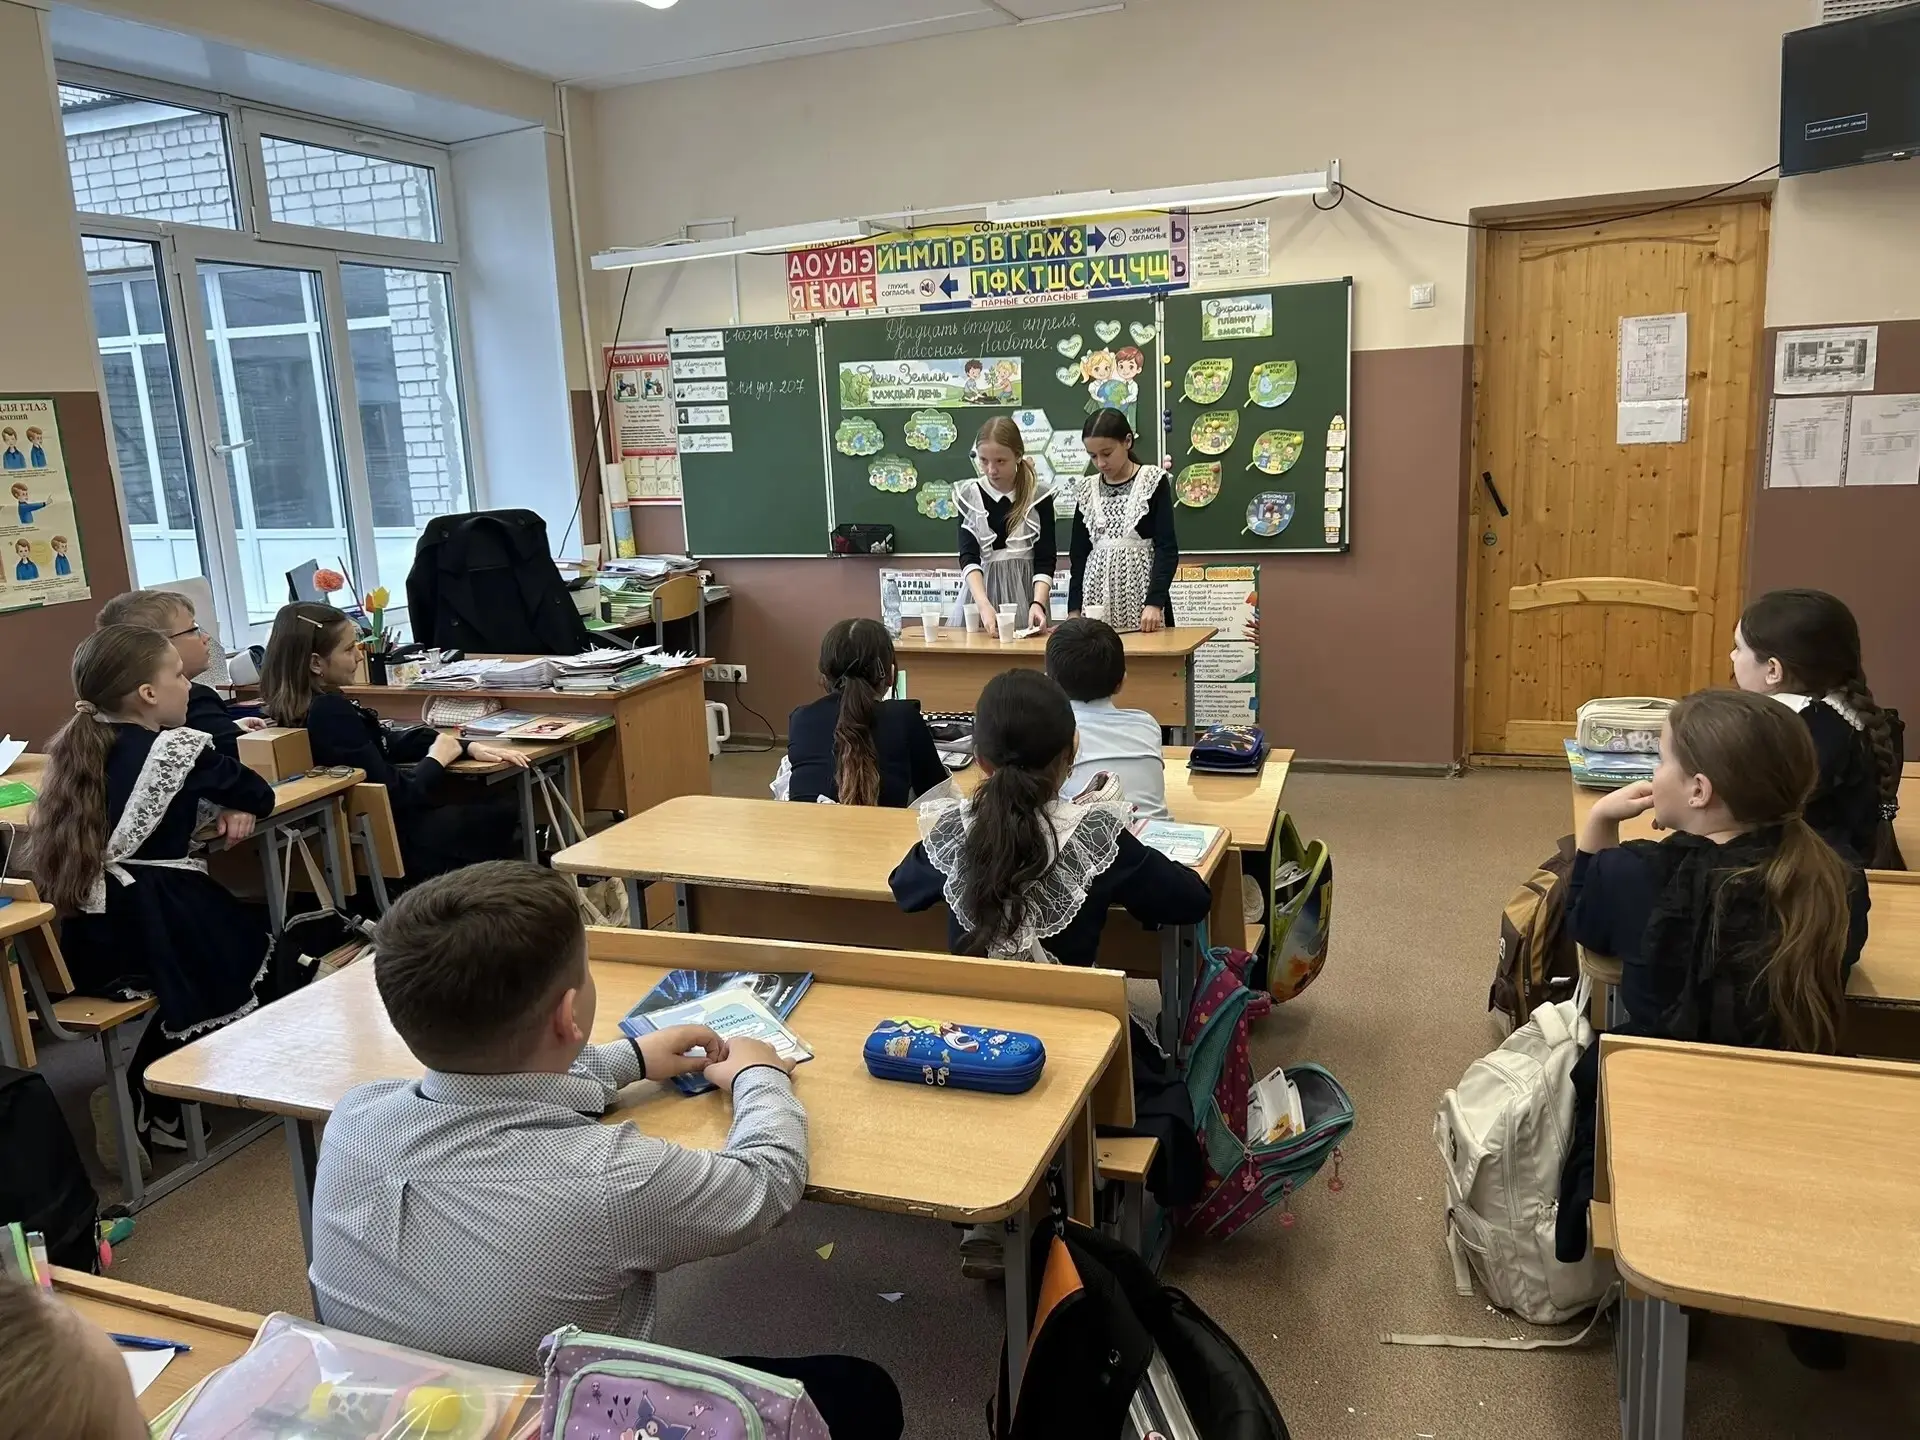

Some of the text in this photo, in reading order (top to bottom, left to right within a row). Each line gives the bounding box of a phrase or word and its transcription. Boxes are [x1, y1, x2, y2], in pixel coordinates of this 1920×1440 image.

[1129, 232, 1168, 241] СОГЛАСНЫЕ
[1131, 226, 1161, 235] ЗВОНКИЕ
[881, 288, 916, 297] СОГЛАСНЫЕ
[981, 293, 1079, 307] ПАРНЫЕ СОГЛАСНЫЕ
[1206, 300, 1265, 318] Сохраним
[1217, 314, 1257, 326] планету
[886, 312, 1081, 346] Двадцать второе апреля.
[1217, 325, 1255, 336] вместе!
[894, 331, 1053, 359] Классная работа.
[612, 352, 670, 364] СИДИ ПРА
[897, 363, 949, 385] Земли
[872, 388, 942, 401] КАЖДЫЙ ДЕНЬ
[20, 403, 47, 411] ГЛАЗ
[704, 1013, 736, 1026] апка-
[713, 1013, 756, 1031] огайка
